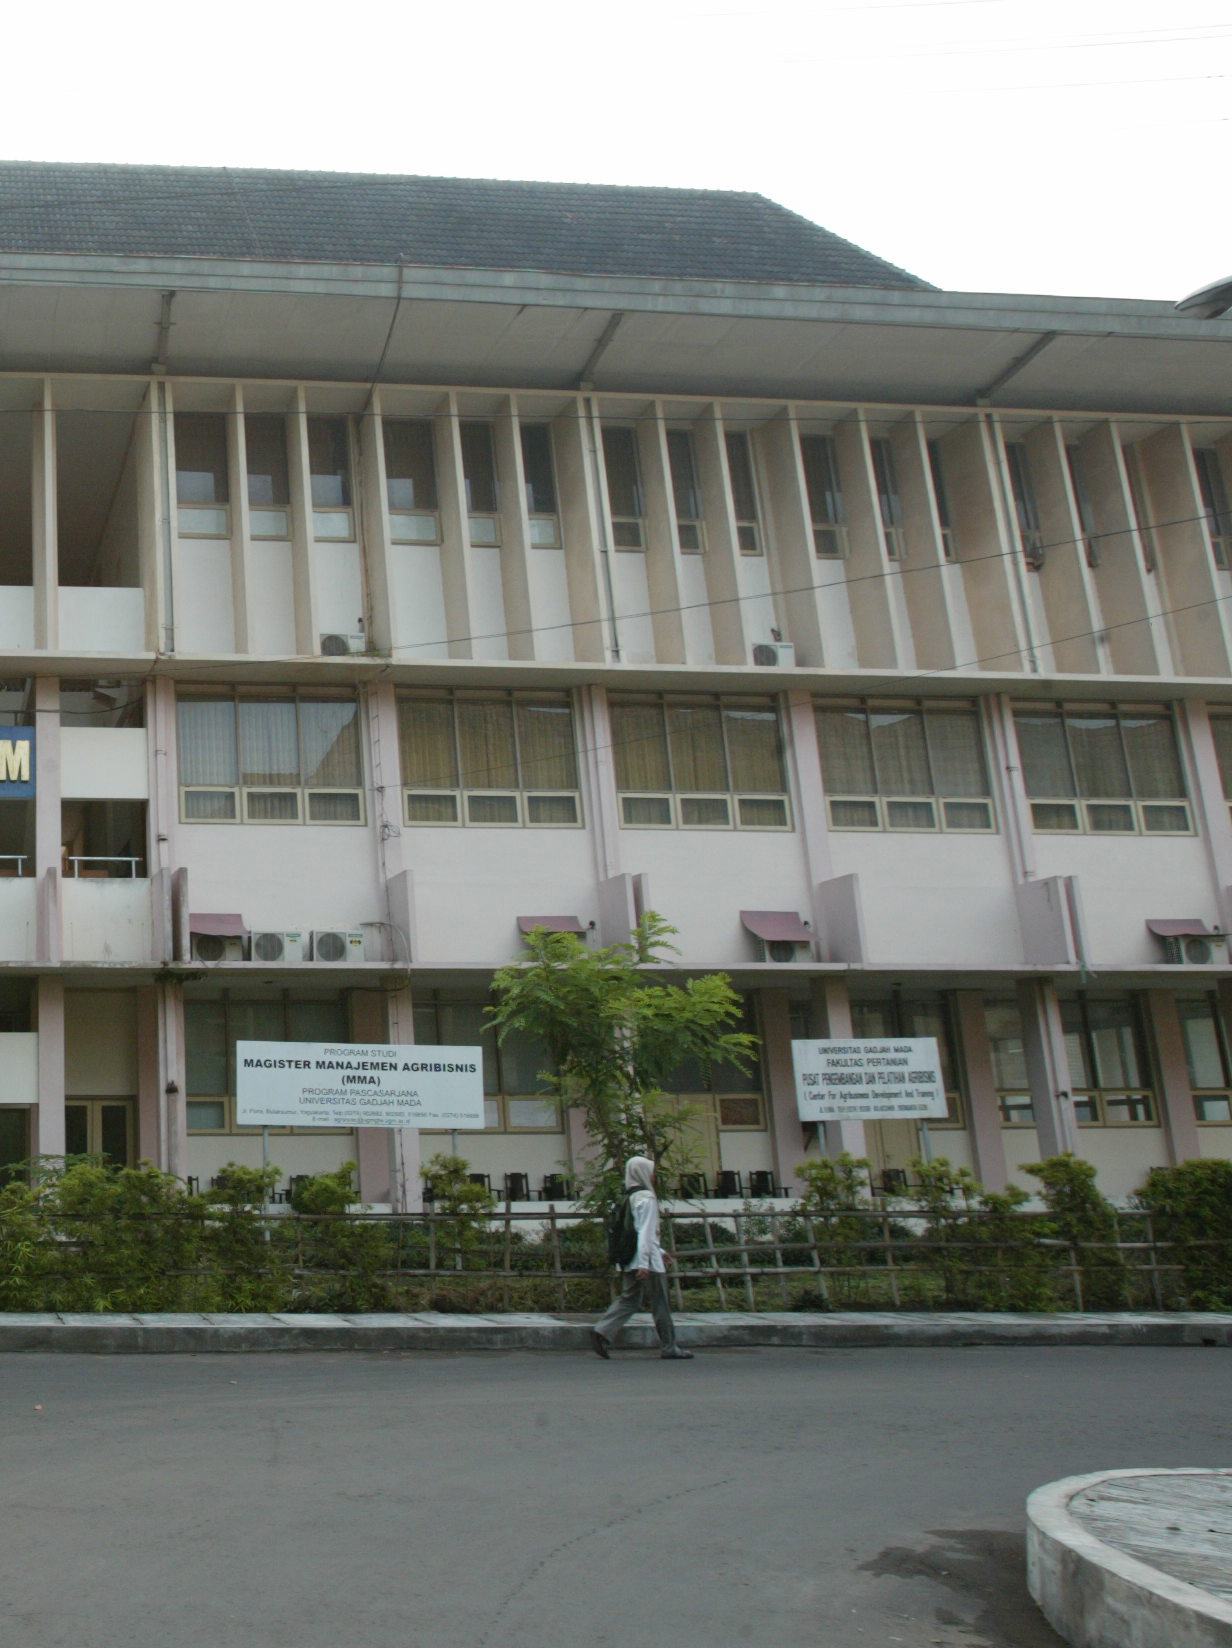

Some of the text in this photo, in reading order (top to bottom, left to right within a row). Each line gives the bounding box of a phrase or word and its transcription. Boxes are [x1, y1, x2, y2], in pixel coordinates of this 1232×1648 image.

[323, 1048, 397, 1058] PROGRAM STUDI
[818, 1046, 861, 1055] UNIVERSITAS
[243, 1058, 477, 1073] MAGISTER MANAJEMEN AGRIBISNIS
[826, 1057, 908, 1067] FAKULTAS PERTANIAN
[341, 1075, 381, 1087] (MMA)
[302, 1087, 419, 1098] PROGRAM PASCASARJANA
[299, 1097, 423, 1107] UNIVERSITAS GADJAH MADA
